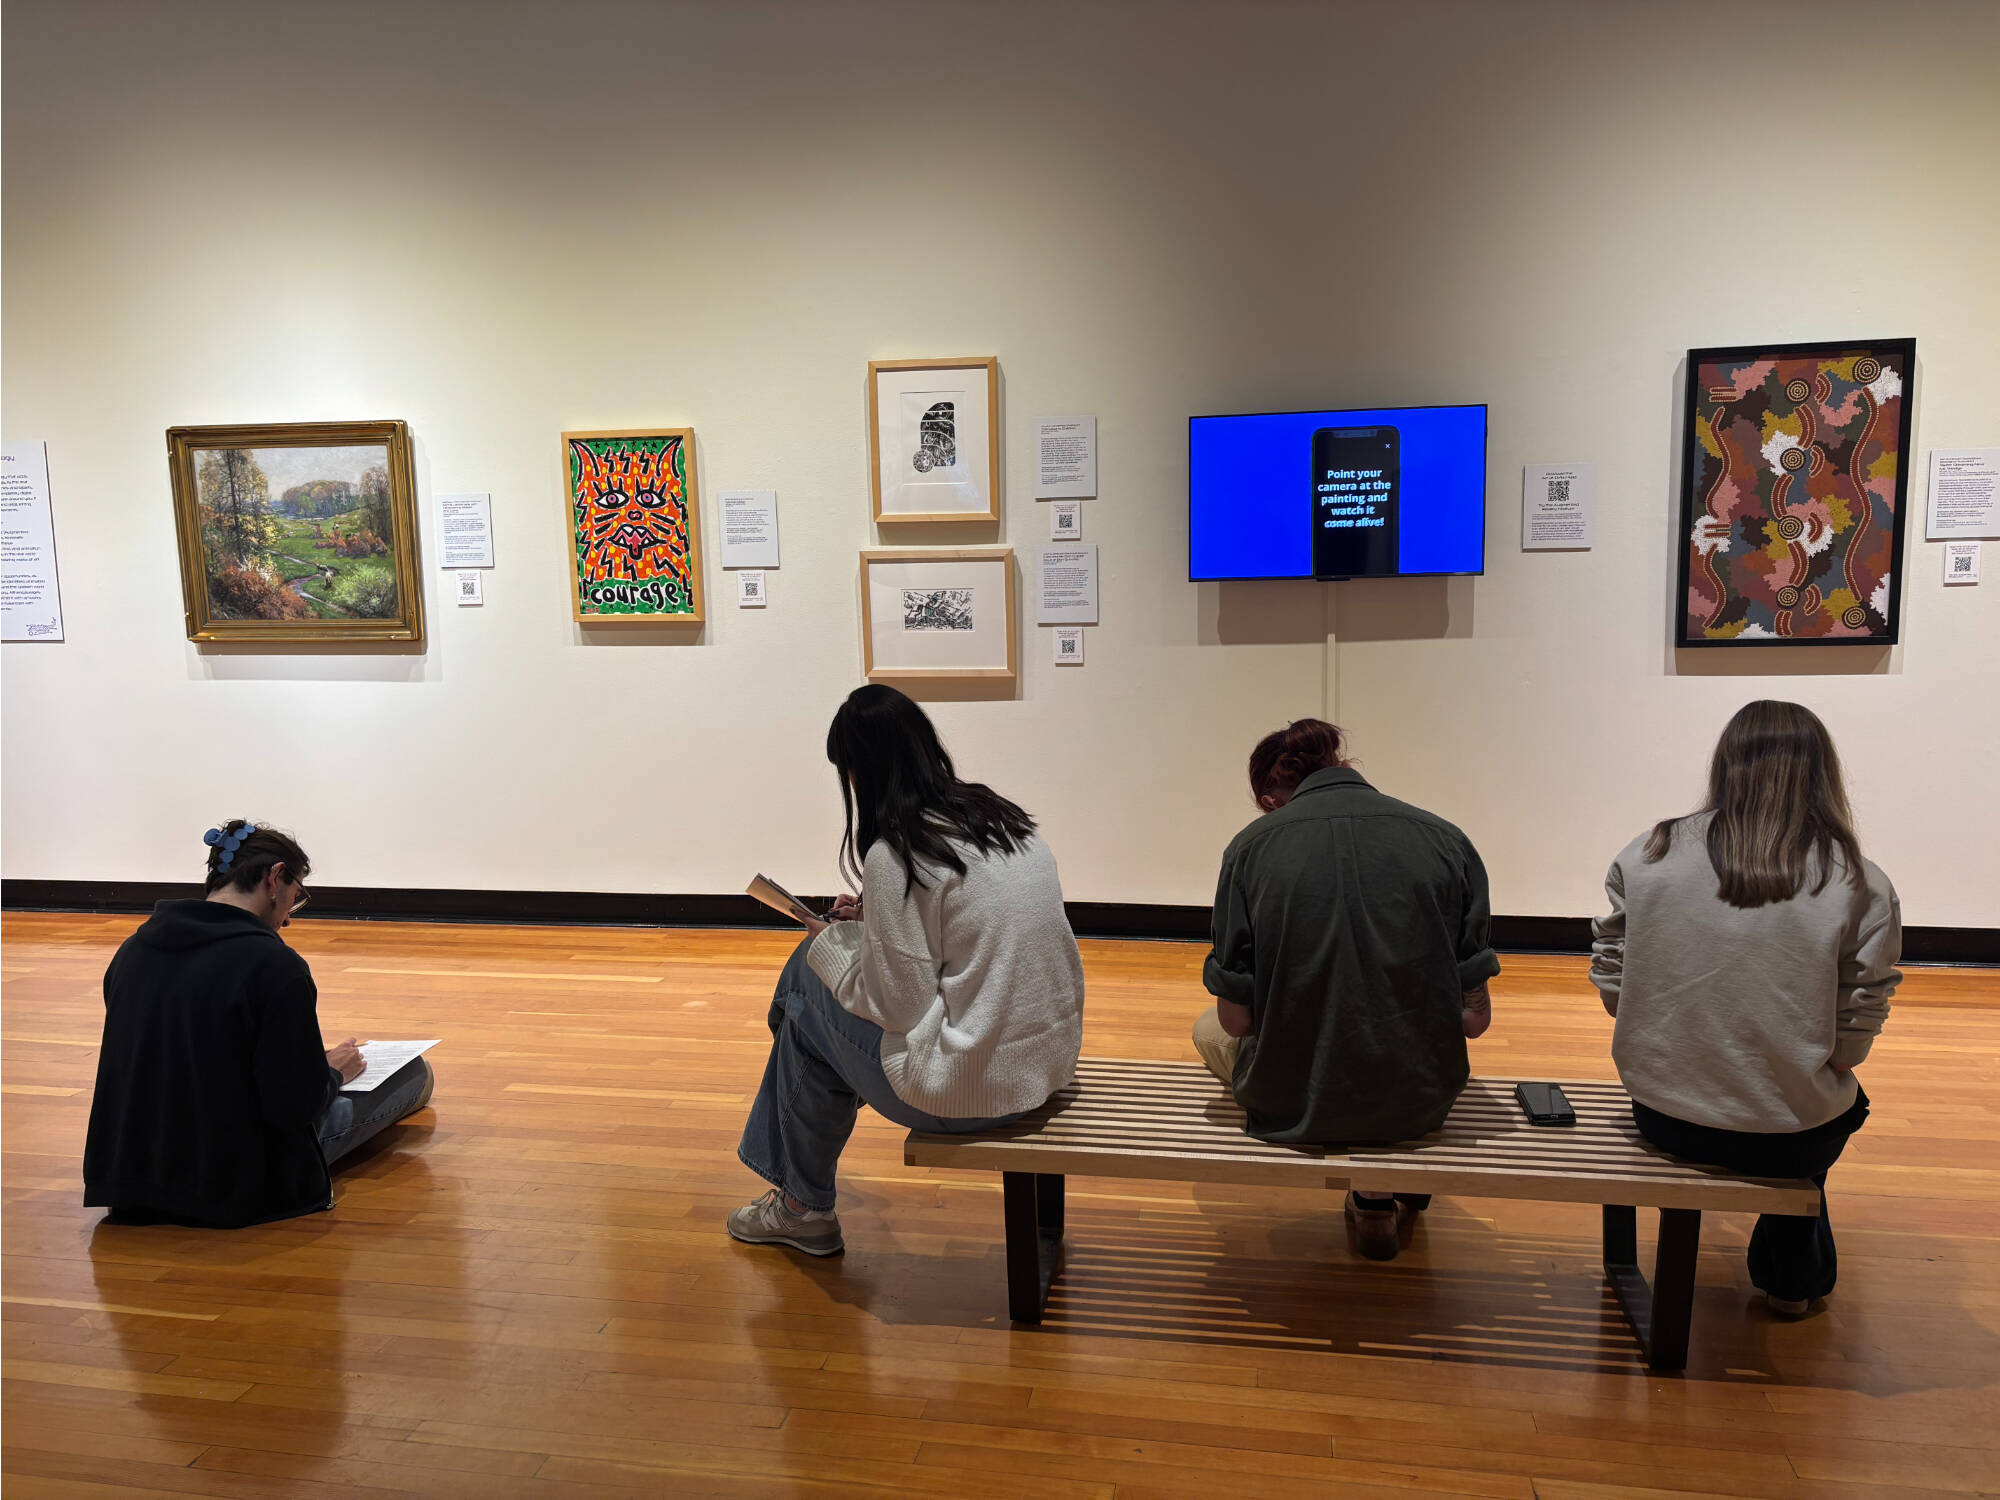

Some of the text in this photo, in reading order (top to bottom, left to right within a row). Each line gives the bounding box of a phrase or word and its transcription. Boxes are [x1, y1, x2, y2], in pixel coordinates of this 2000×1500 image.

[1327, 469, 1382, 480] Point your
[1317, 480, 1391, 492] camera at the
[1321, 492, 1388, 506] painting and
[1331, 505, 1375, 516] watch it
[1324, 517, 1385, 528] come alive!
[590, 581, 681, 610] courage
